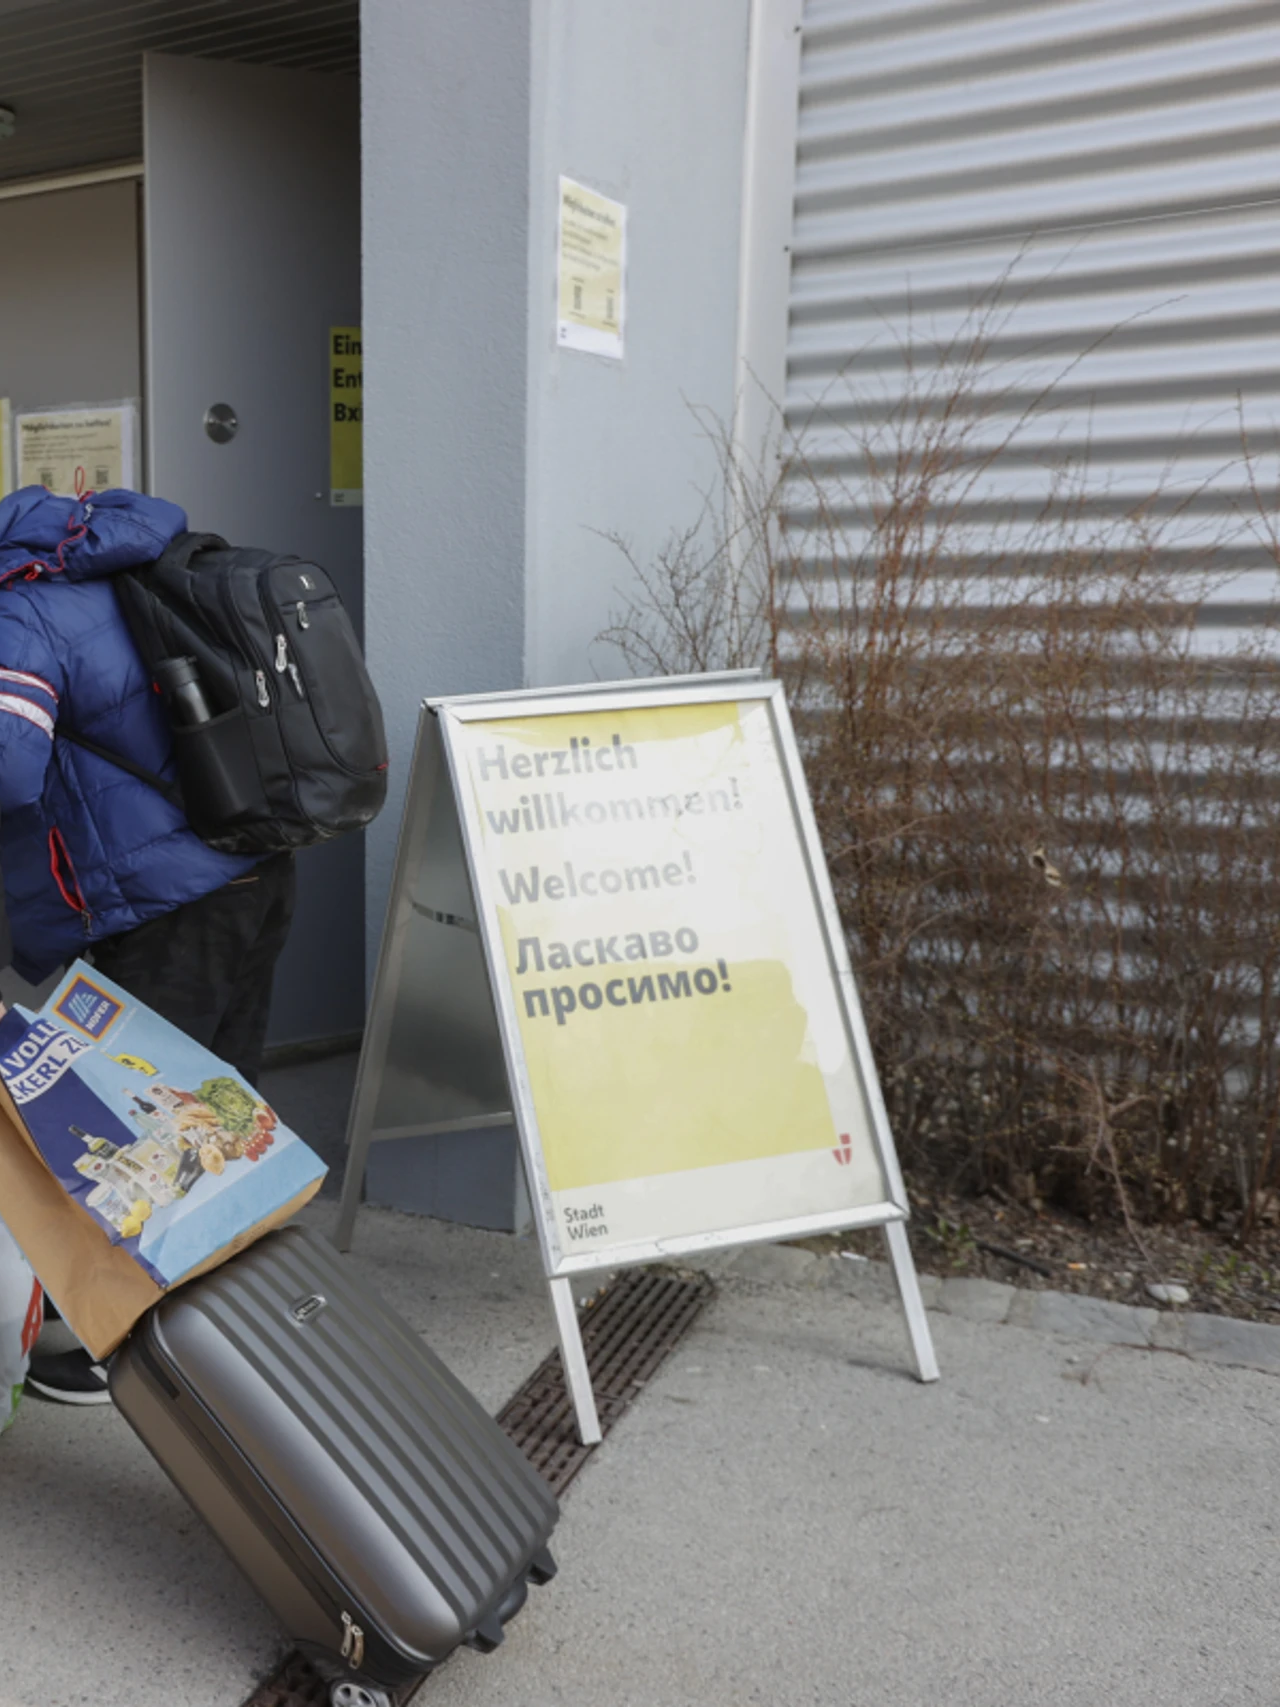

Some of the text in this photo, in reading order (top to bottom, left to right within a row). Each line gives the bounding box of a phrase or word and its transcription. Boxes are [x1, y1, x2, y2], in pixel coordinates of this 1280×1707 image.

[333, 335, 363, 355] Ein
[333, 368, 363, 388] Ent
[477, 734, 638, 781] Herzlich
[486, 776, 743, 834] willkommen!
[498, 850, 697, 904] Welcome!
[516, 926, 699, 975] Ласкаво
[522, 957, 732, 1026] просимо!
[13, 1055, 68, 1101] KERL
[563, 1203, 605, 1223] Stadt
[566, 1222, 609, 1240] Wien
